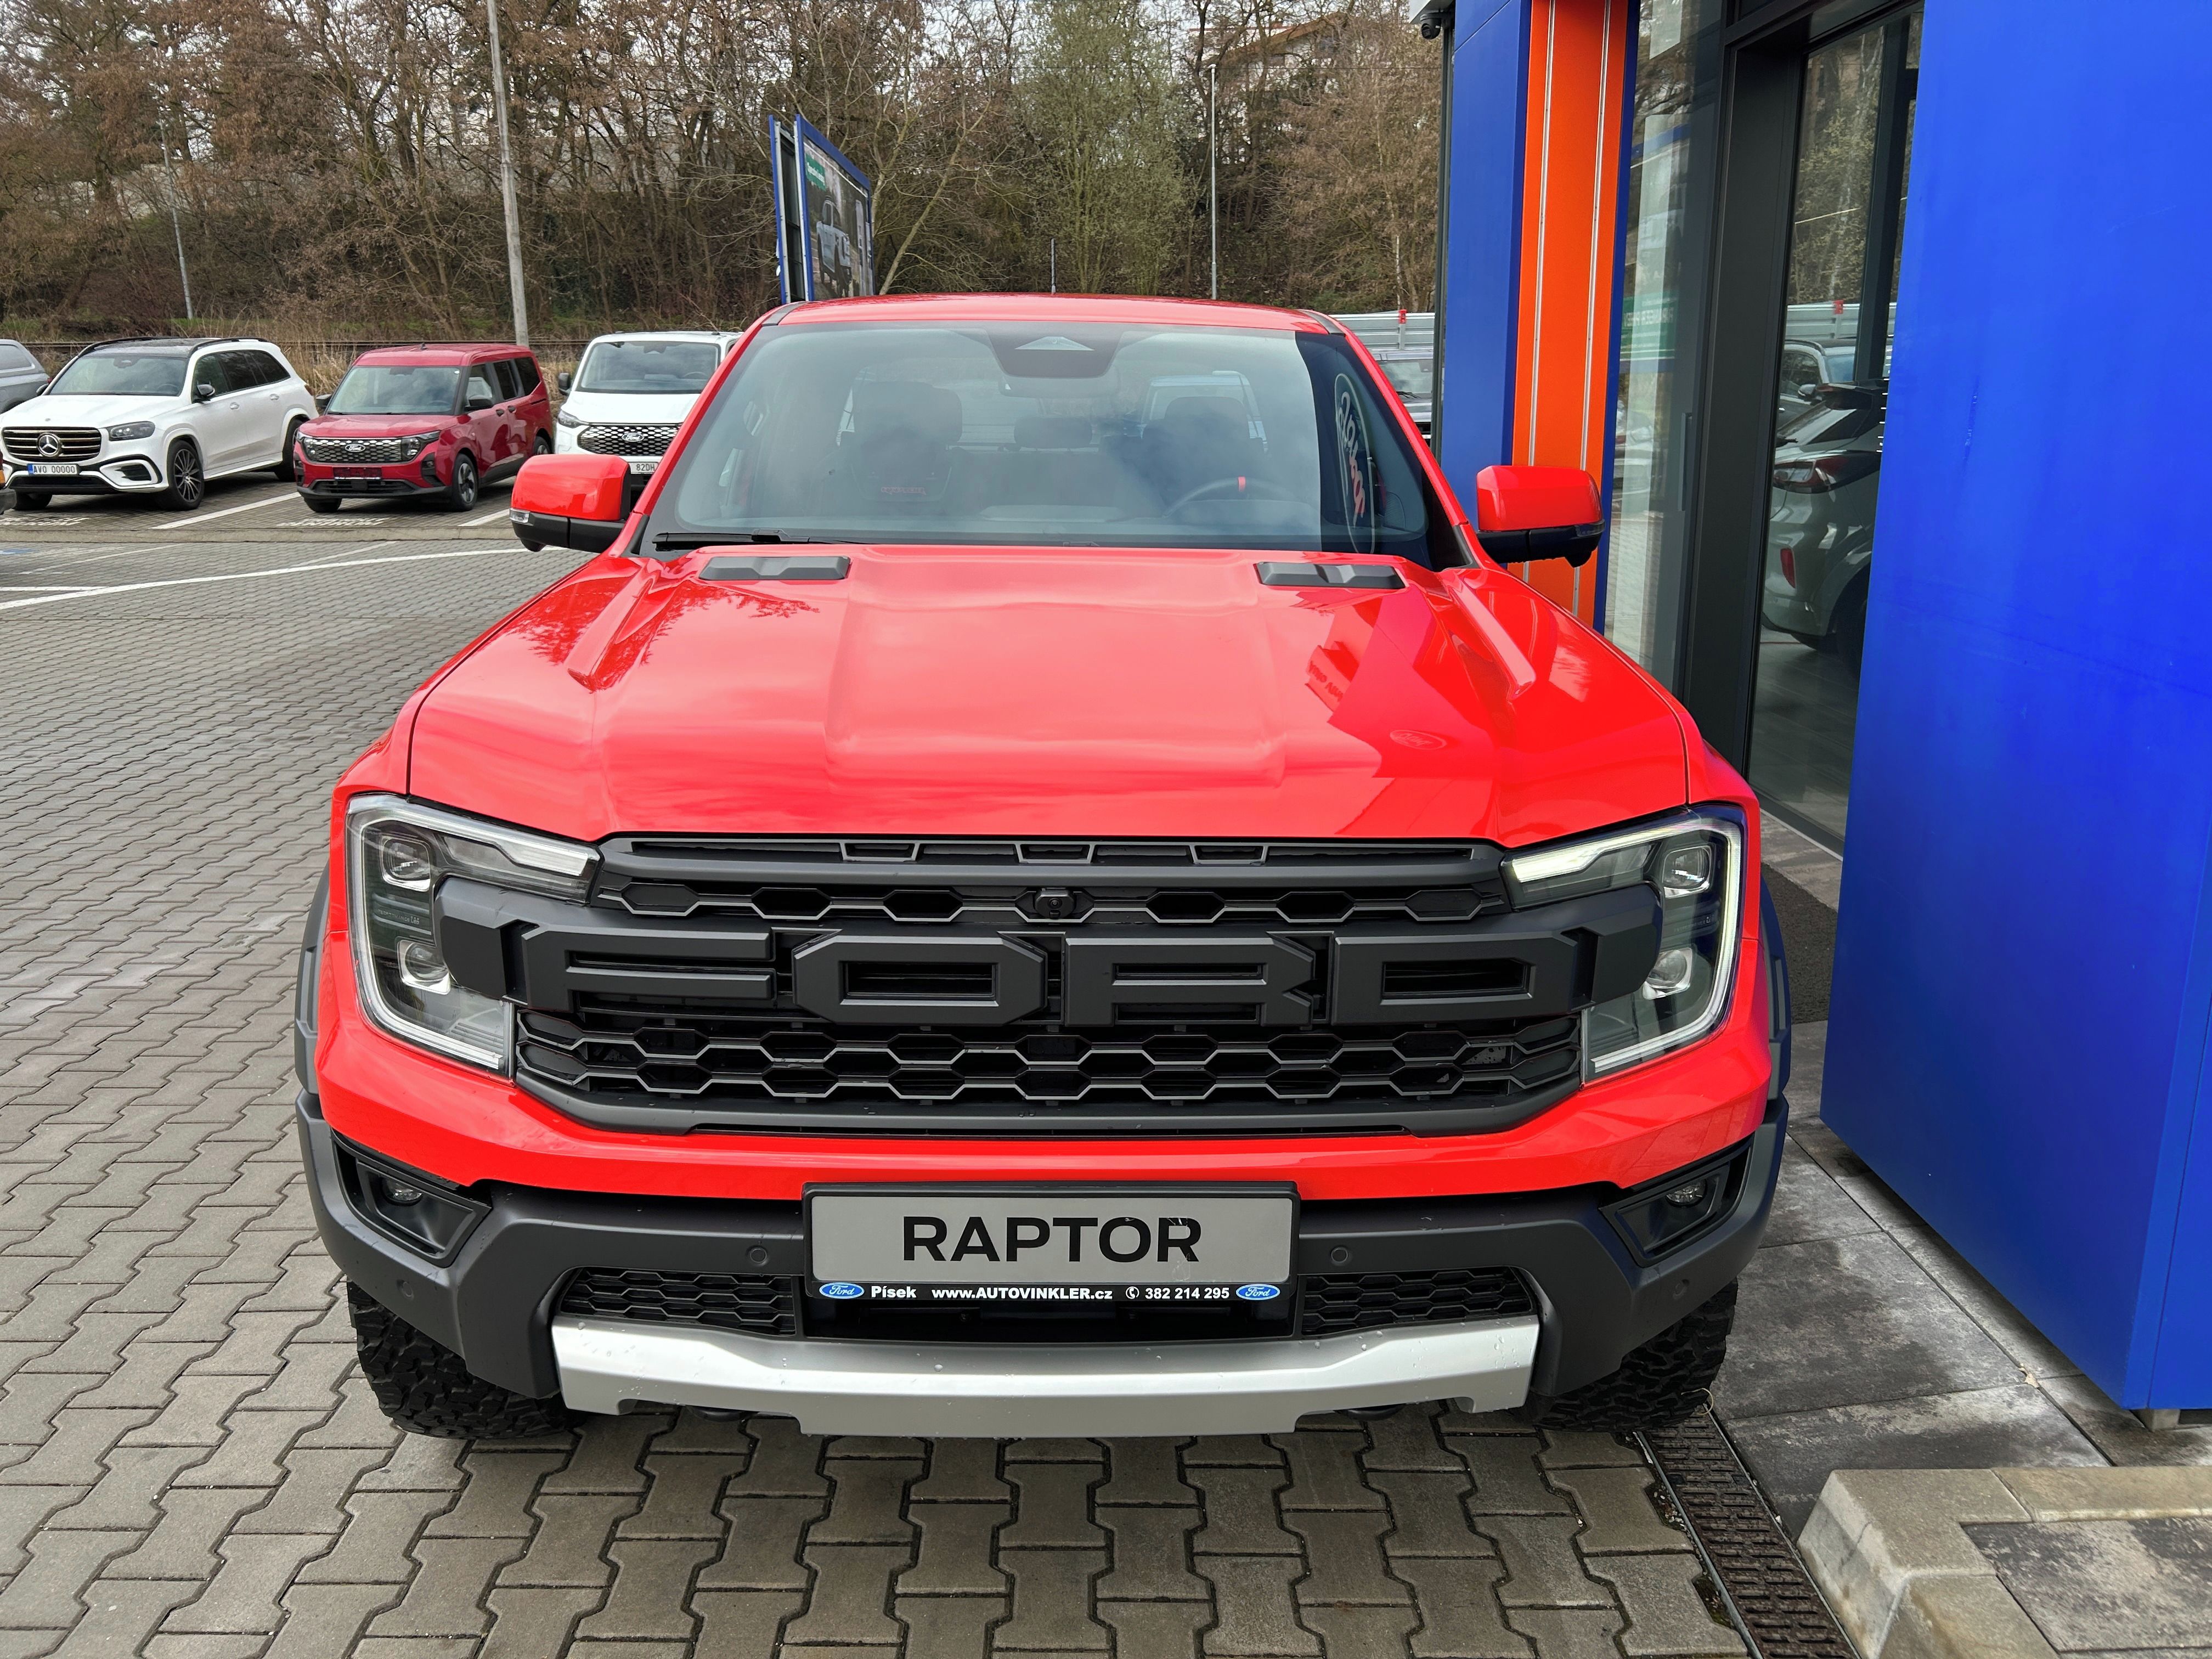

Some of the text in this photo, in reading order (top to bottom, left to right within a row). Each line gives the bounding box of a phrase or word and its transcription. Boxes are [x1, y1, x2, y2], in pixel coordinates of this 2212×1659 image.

[521, 924, 1578, 1027] FORD
[903, 1216, 1202, 1263] RAPTOR
[871, 1285, 917, 1298] Písek
[931, 1287, 1113, 1300] www.AUTOVINKLER.cz
[1145, 1287, 1170, 1299] 382
[1174, 1287, 1200, 1299] 214
[1204, 1287, 1230, 1299] 295
